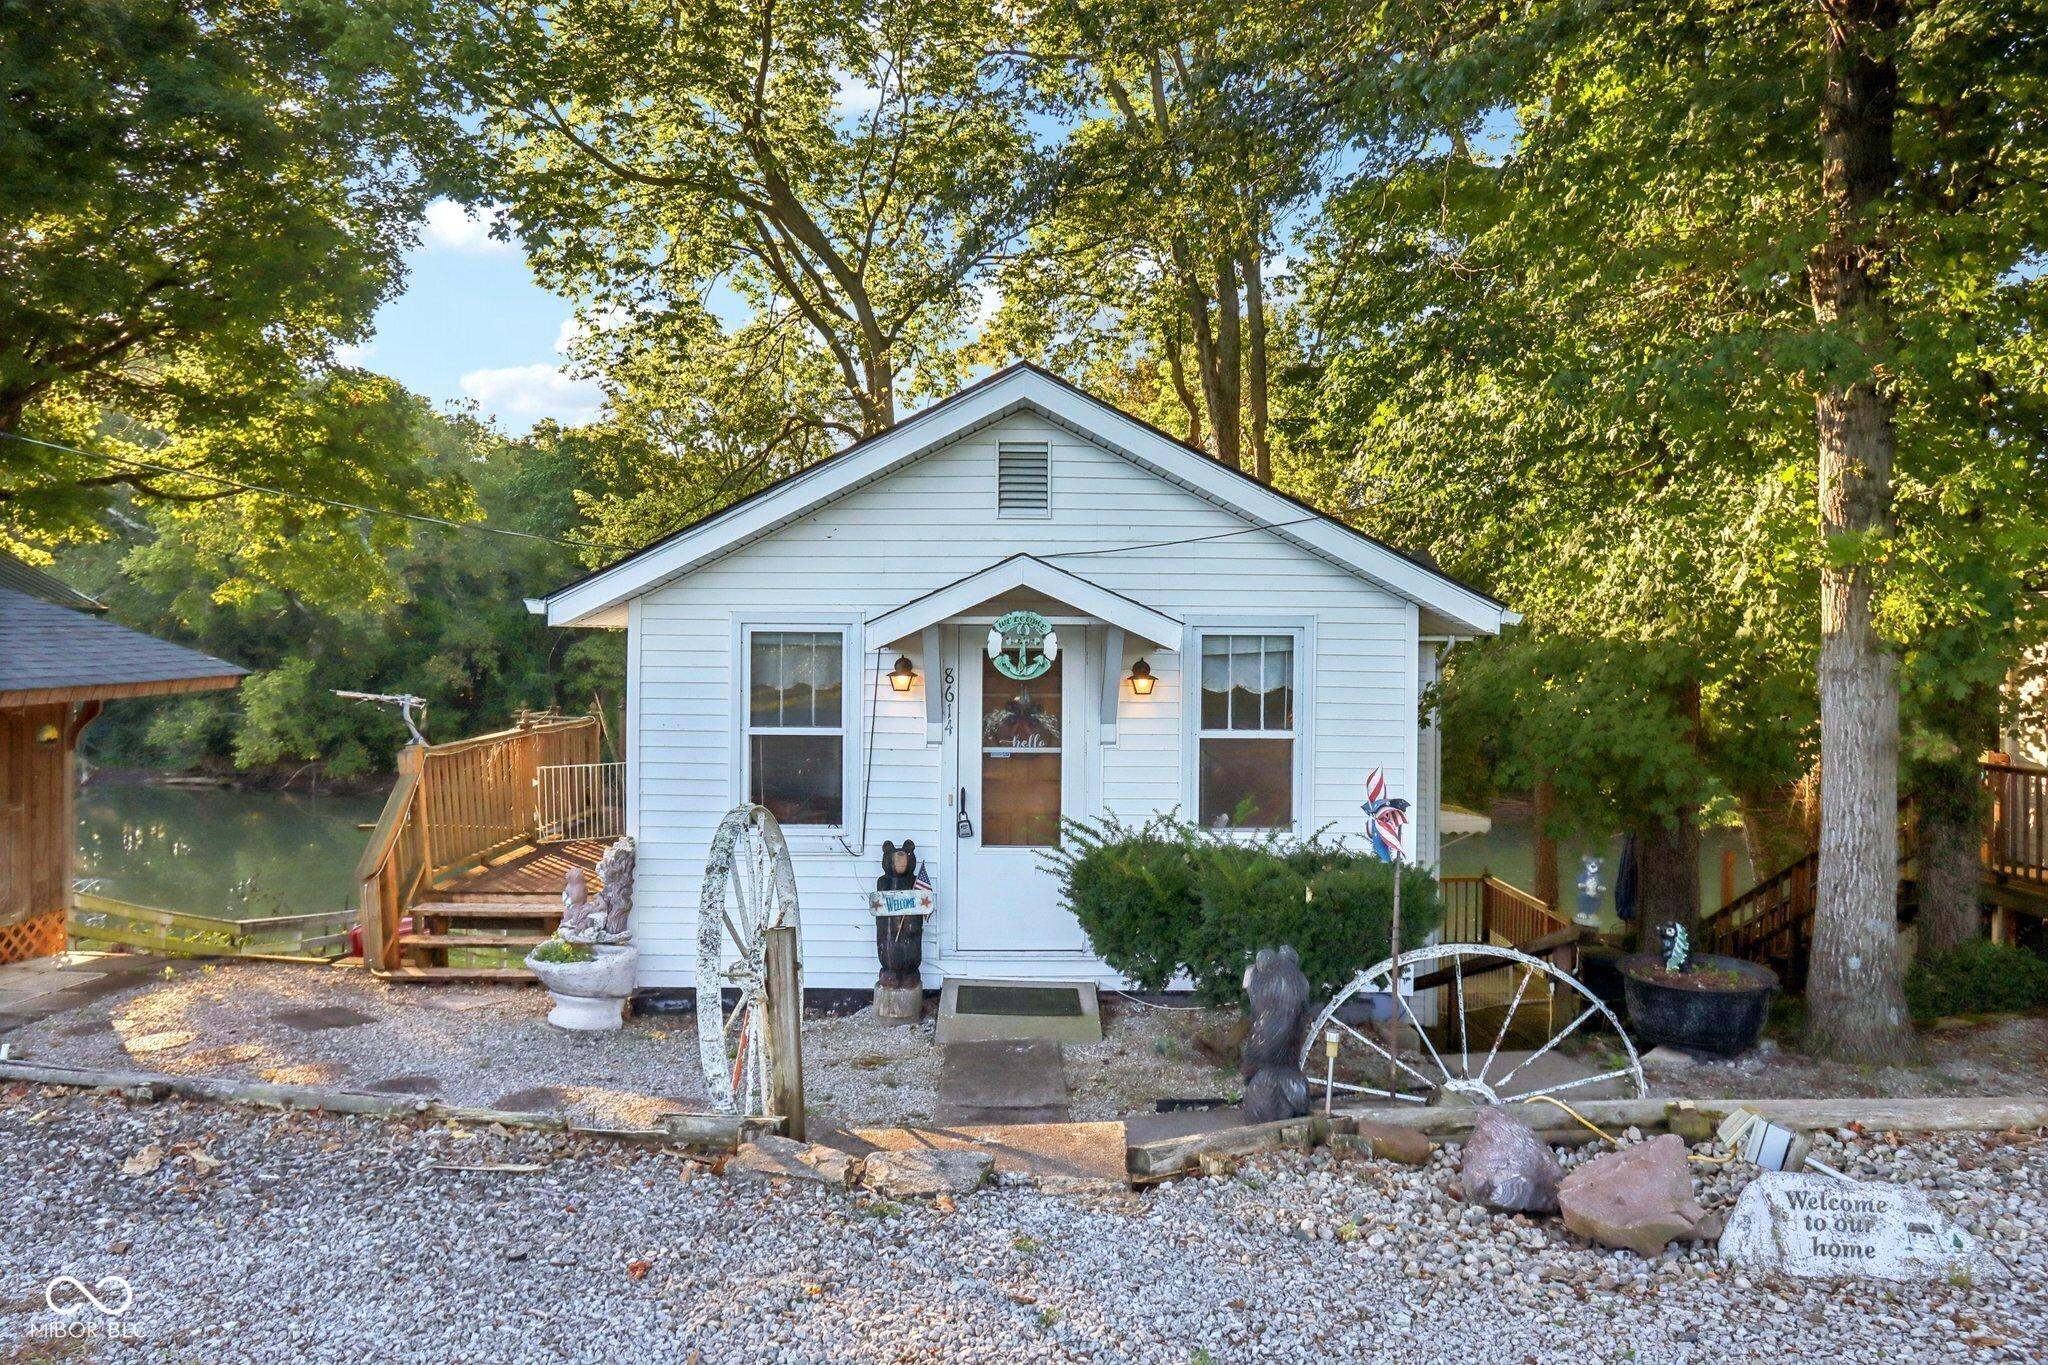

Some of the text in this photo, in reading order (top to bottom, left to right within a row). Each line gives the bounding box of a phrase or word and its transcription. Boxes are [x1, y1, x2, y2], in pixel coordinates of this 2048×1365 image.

[944, 667, 955, 737] 8614
[1001, 733, 1046, 748] hello
[885, 896, 916, 913] WELCOME
[1785, 1190, 1888, 1213] Welcome
[1804, 1216, 1876, 1233] to our
[1813, 1236, 1876, 1259] home
